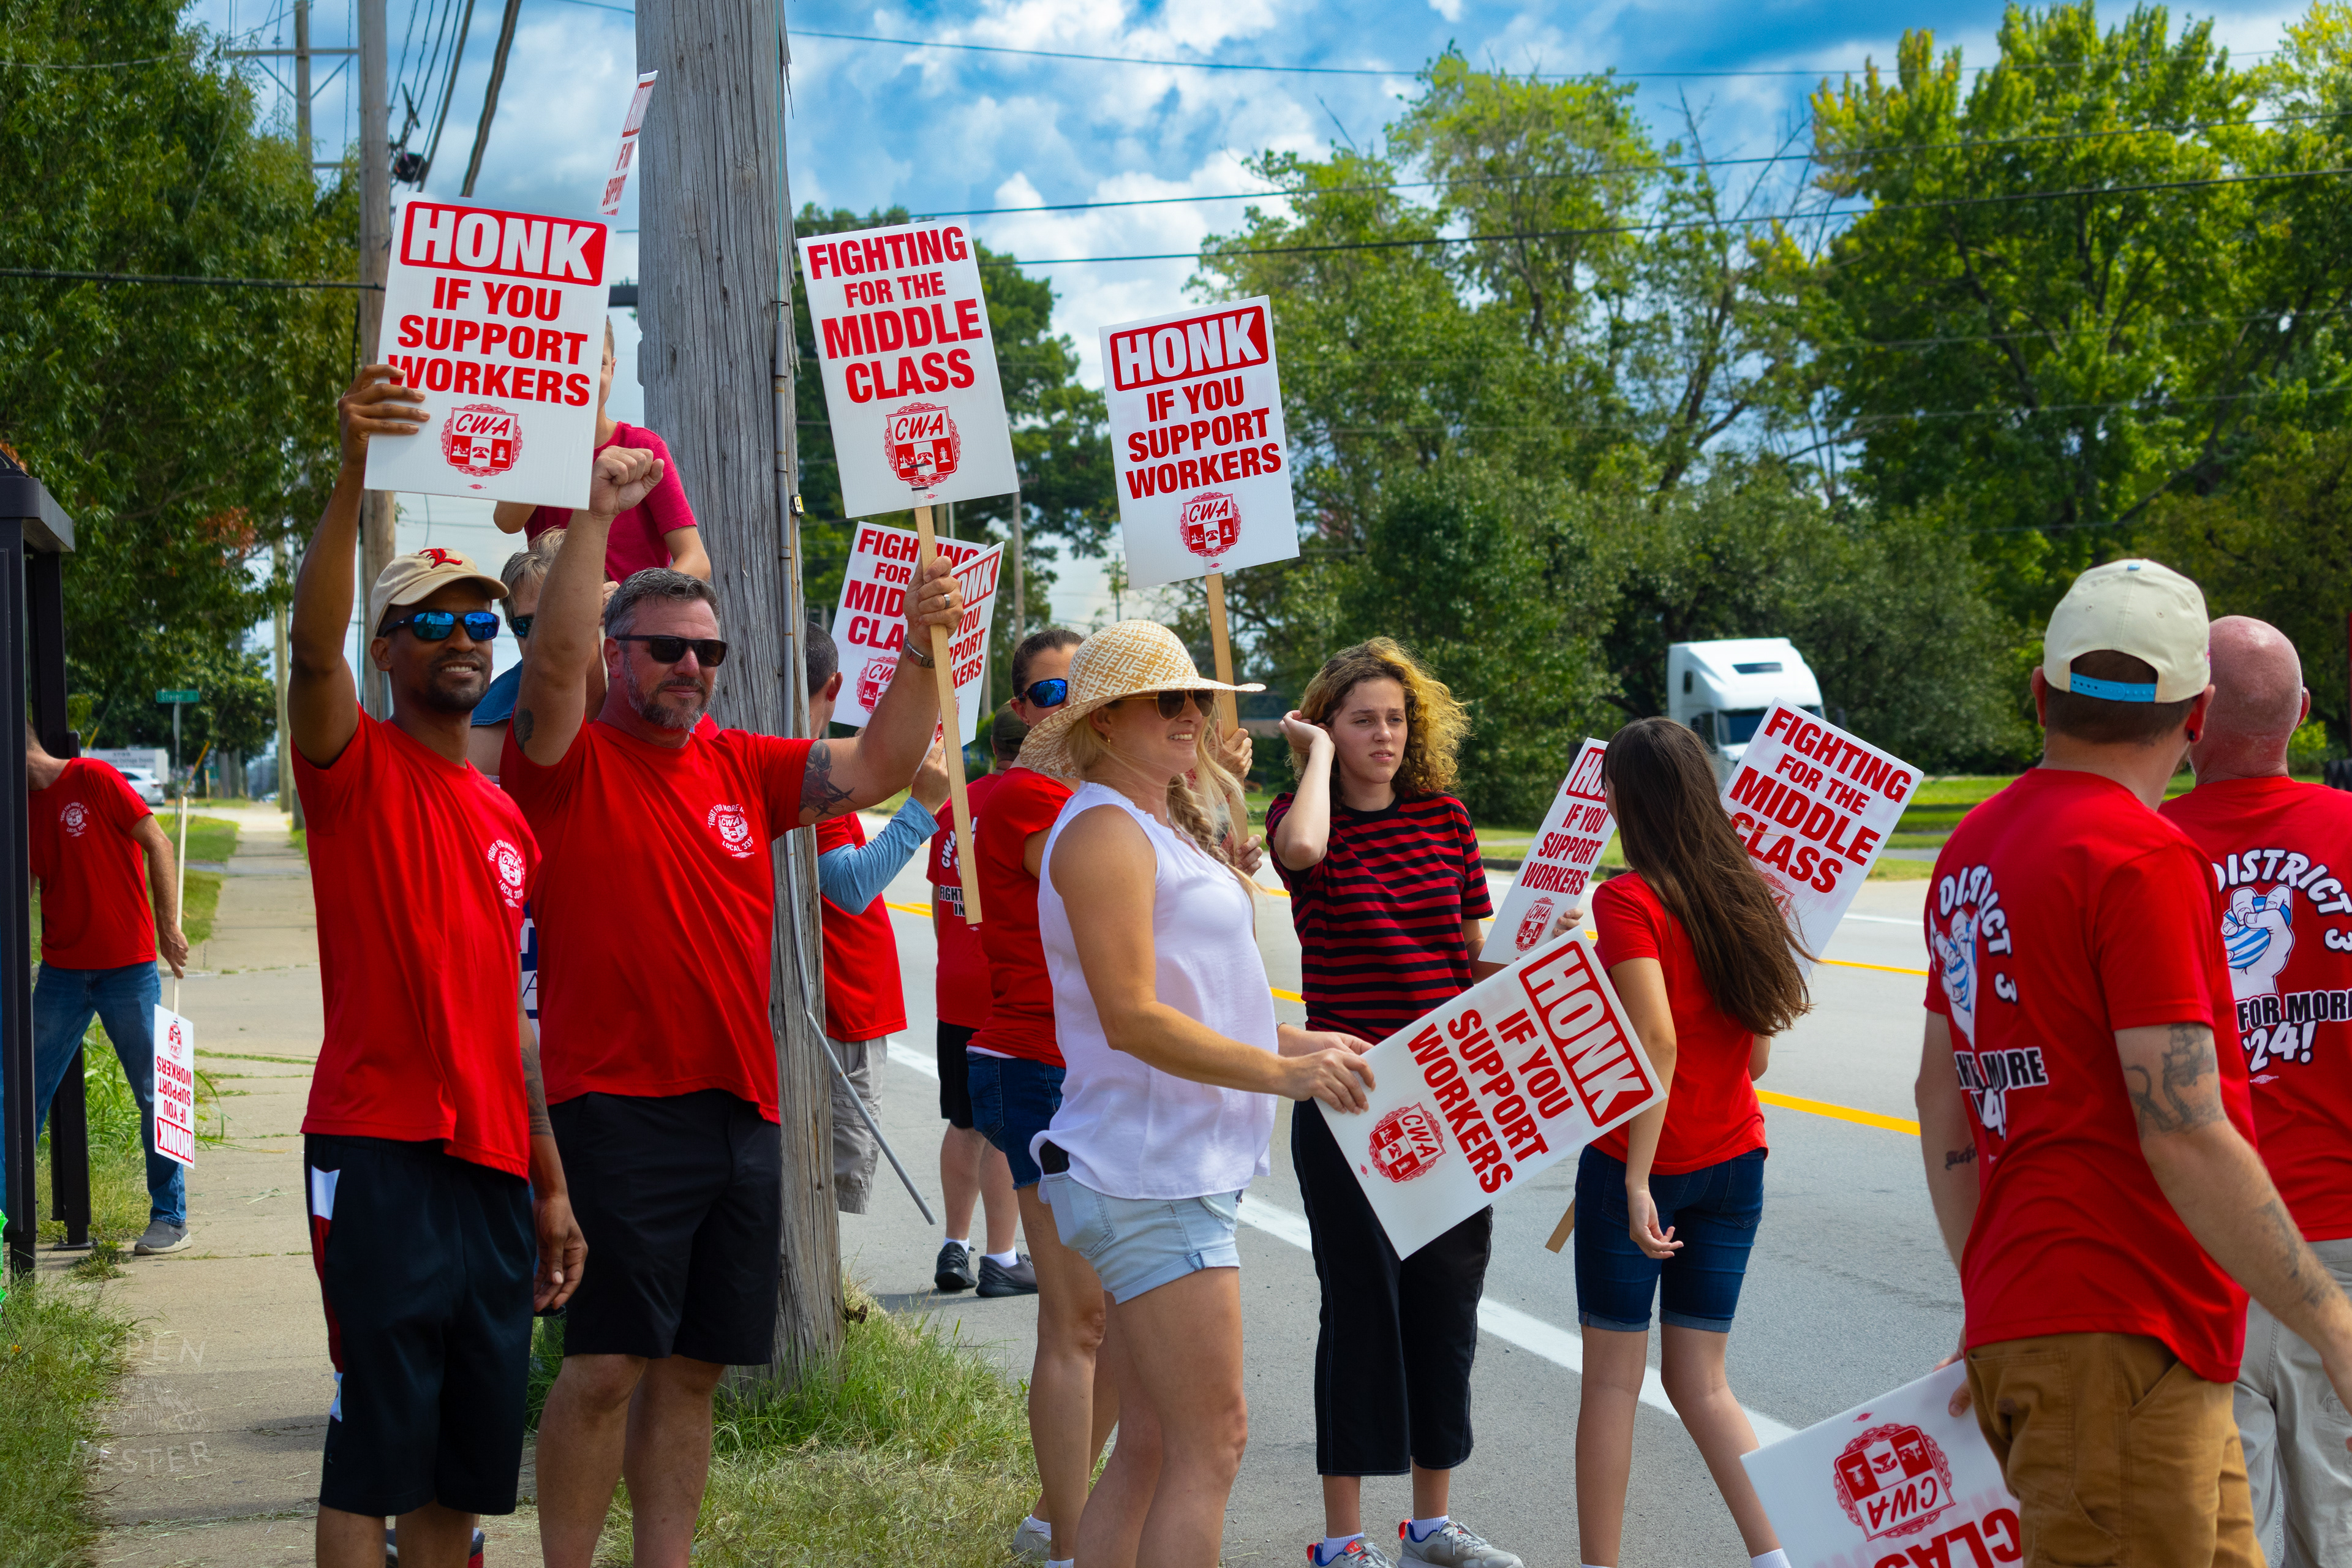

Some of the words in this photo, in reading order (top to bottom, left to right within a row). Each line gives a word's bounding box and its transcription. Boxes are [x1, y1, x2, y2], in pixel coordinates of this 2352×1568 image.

[409, 207, 597, 280] HONK
[807, 226, 968, 280] FIGHTING
[432, 277, 471, 311] IF
[483, 281, 562, 322] YOU
[843, 279, 894, 308] FOR
[897, 271, 946, 301] THE
[398, 314, 588, 365] SUPPORT
[821, 298, 984, 360] MIDDLE
[1117, 312, 1262, 385] HONK
[388, 354, 590, 407] WORKERS
[845, 348, 975, 404] CLASS
[1146, 389, 1175, 423] IF
[1181, 375, 1245, 415] YOU
[456, 413, 511, 437] CWA
[895, 413, 943, 441] CWA
[1128, 407, 1270, 462] SUPPORT
[1125, 443, 1282, 500] WORKERS
[1188, 499, 1229, 523] CWA
[873, 562, 912, 585] FOR
[958, 556, 997, 608] ONK
[844, 579, 906, 618] MID
[848, 616, 905, 653] CLA
[869, 664, 895, 682] CW
[953, 654, 983, 690] KERS
[1570, 752, 1608, 798] HO
[1764, 707, 1912, 804] FIGHTING
[1775, 753, 1823, 793] FOR
[1825, 777, 1871, 816] THE
[714, 804, 723, 813] FOR
[723, 804, 740, 812] MORE
[722, 816, 740, 827] CWA
[1562, 803, 1584, 829] IF
[1578, 806, 1610, 834] YOU
[1729, 765, 1881, 866] MIDDLE
[502, 855, 518, 869] CWA
[722, 840, 742, 851] LOCAL
[941, 830, 956, 869] CWA
[1538, 832, 1603, 865] SUPPORT
[1731, 812, 1843, 894] CLASS
[1521, 861, 1589, 896] WORKERS
[1529, 904, 1549, 921] CWA
[2325, 928, 2352, 953] 3
[1995, 972, 2018, 1003] 3
[2236, 993, 2281, 1033] FOR
[2285, 988, 2352, 1024] MOR
[170, 1042, 181, 1056] CWA
[1526, 954, 1645, 1120] HONK
[2242, 1019, 2318, 1073] '24!
[156, 1055, 192, 1088] WORKERS
[1495, 1008, 1539, 1046] IF
[1517, 1044, 1575, 1120] YOU
[158, 1077, 190, 1107] SUPPORT
[1447, 1009, 1549, 1163] SUPPORT
[164, 1099, 178, 1121] YOU
[179, 1107, 186, 1125] IF
[1408, 1022, 1513, 1194] WORKERS
[158, 1120, 192, 1161] HONK
[1401, 1114, 1437, 1159] CWA
[1866, 1476, 1937, 1530] CWA
[1874, 1508, 2022, 1568] CLA
